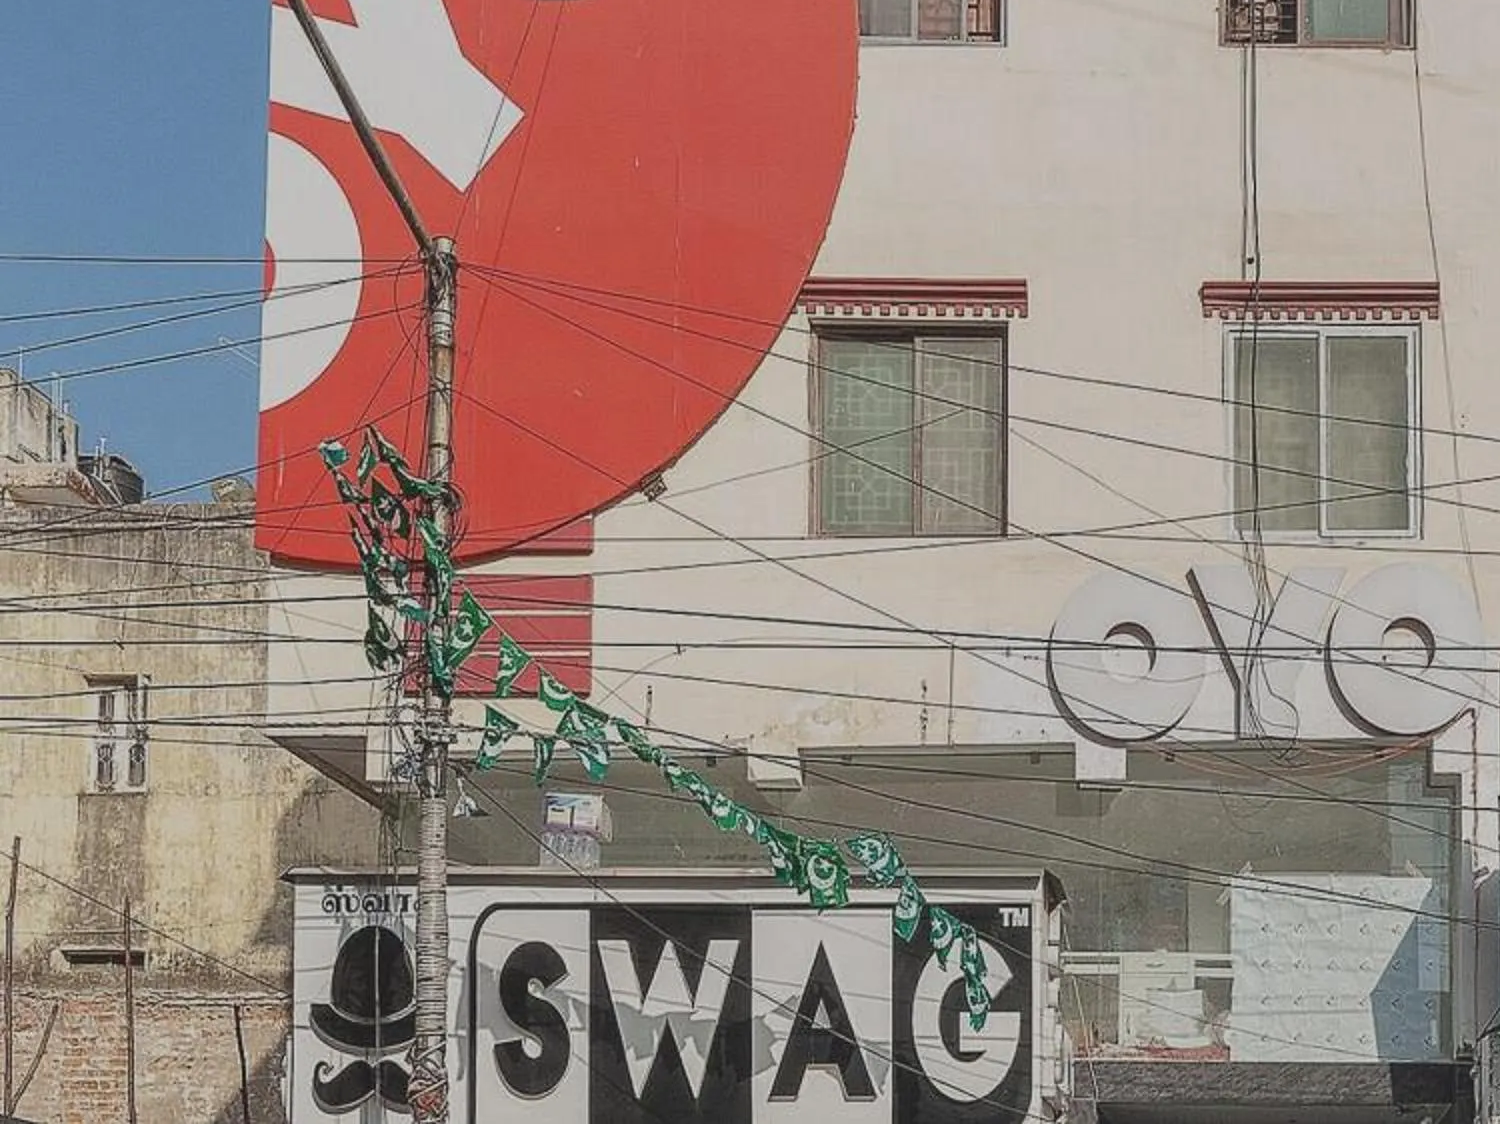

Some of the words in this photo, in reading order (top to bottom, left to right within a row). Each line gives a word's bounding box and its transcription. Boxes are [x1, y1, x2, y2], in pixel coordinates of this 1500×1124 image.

[1047, 562, 1486, 748] OYO
[321, 884, 421, 924] ஸ்வா
[999, 907, 1030, 928] TM
[494, 936, 1022, 1104] SWAG
